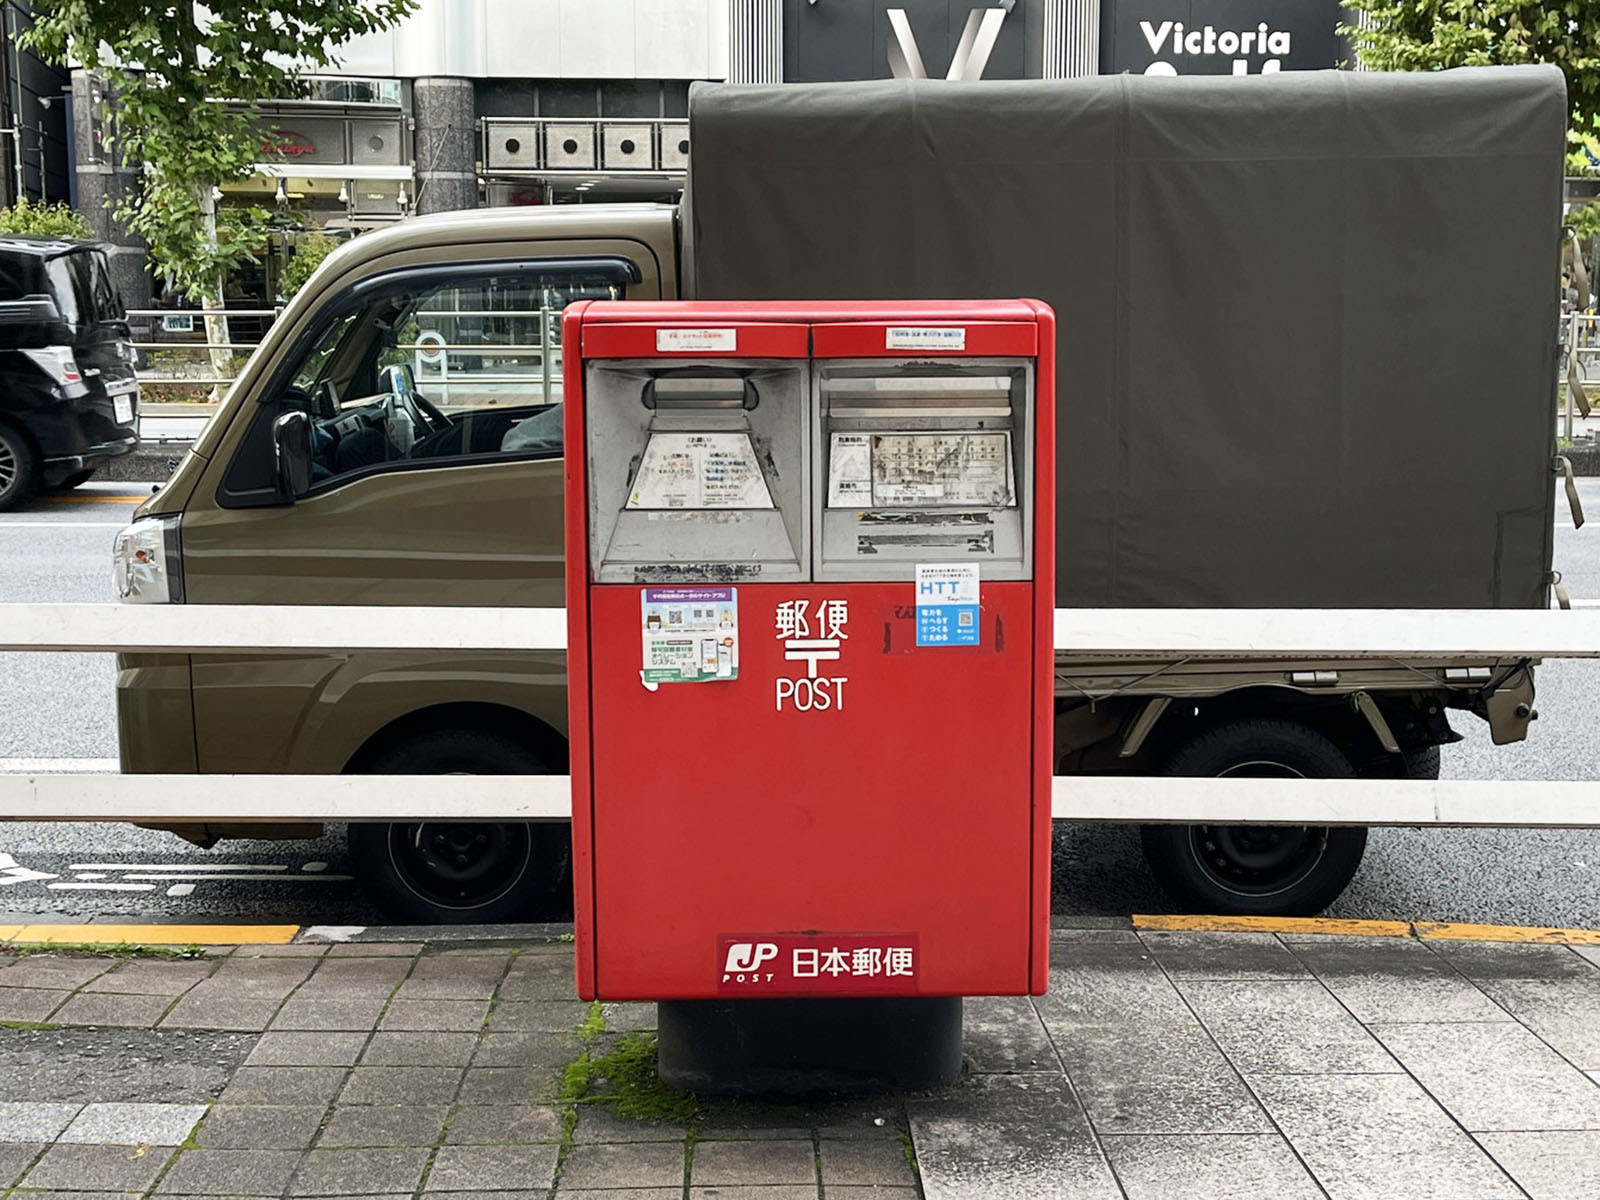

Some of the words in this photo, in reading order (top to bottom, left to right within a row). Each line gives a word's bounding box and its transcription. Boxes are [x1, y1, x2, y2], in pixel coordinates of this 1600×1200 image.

[1139, 21, 1291, 54] Victoria
[920, 582, 959, 594] HTT
[775, 600, 849, 642] 郵便
[776, 676, 848, 711] POST
[792, 946, 914, 977] 日本郵便
[722, 973, 775, 983] POST
